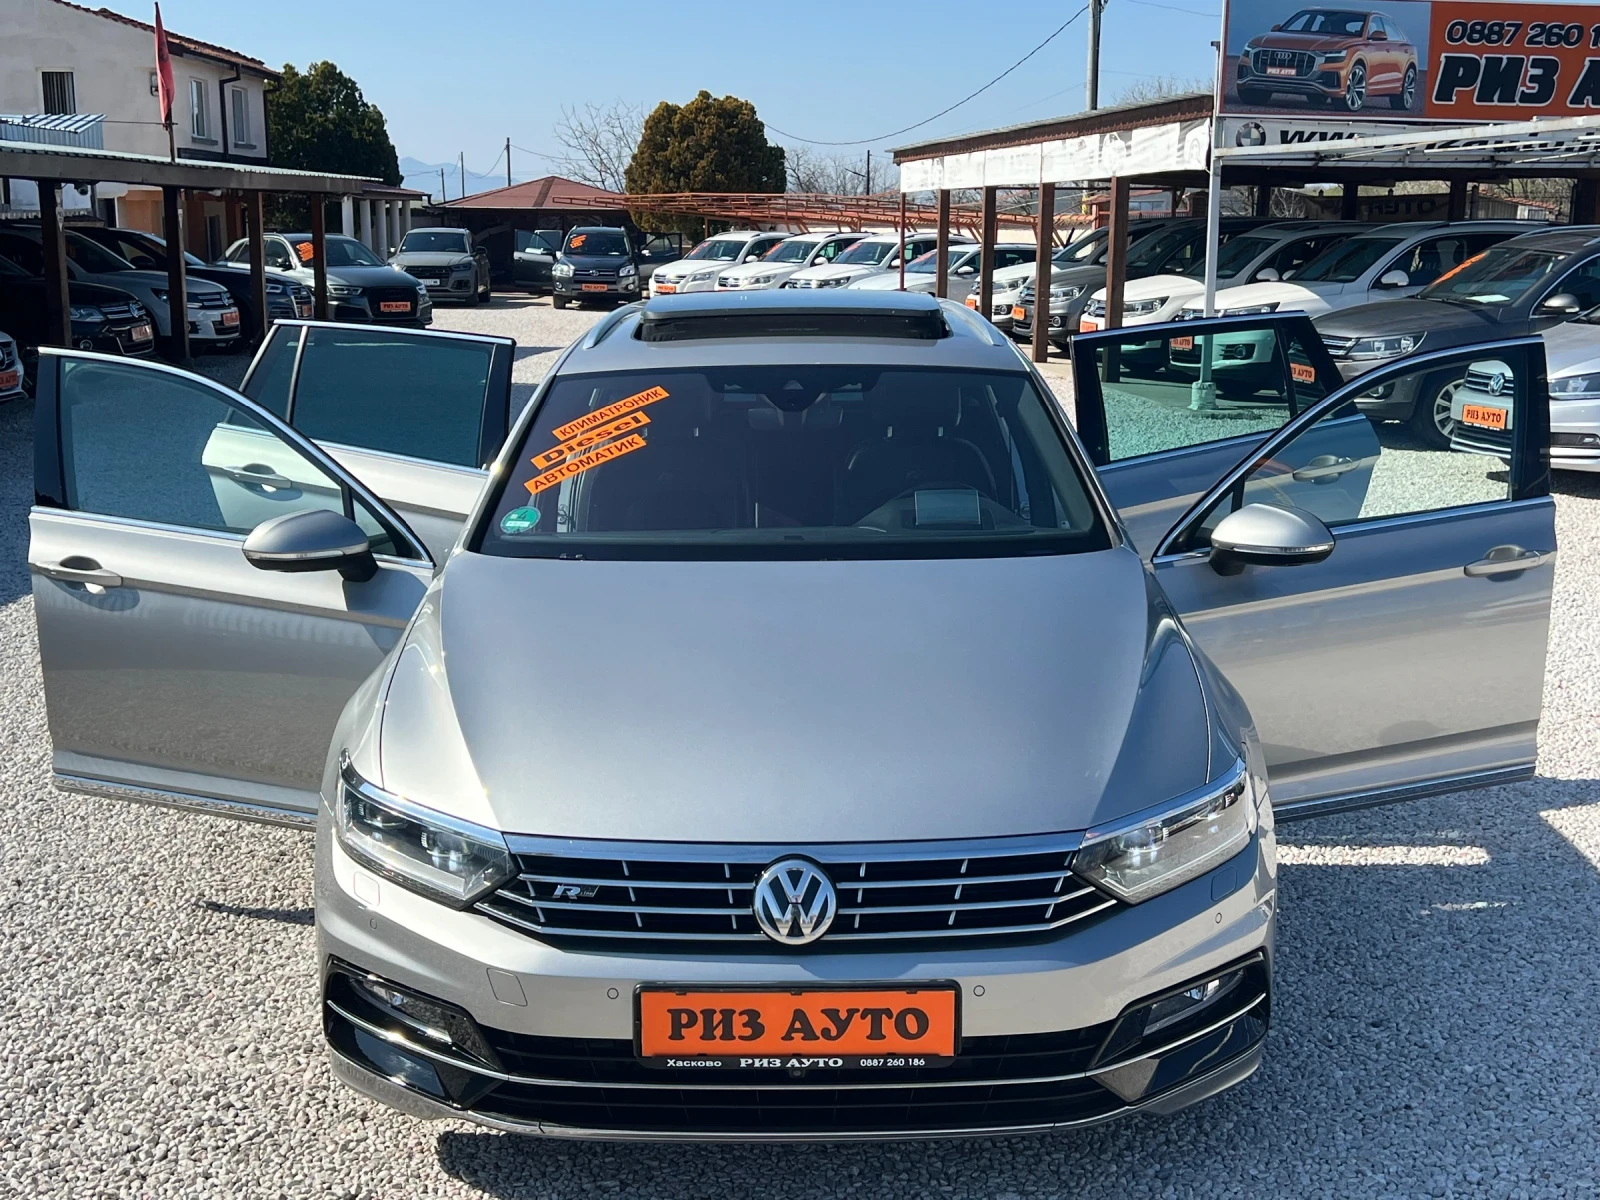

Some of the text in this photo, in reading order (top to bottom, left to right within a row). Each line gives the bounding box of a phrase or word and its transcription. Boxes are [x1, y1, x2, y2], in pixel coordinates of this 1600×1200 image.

[1446, 19, 1523, 46] 0887
[1524, 21, 1584, 48] 260
[1432, 53, 1560, 106] РИЗ
[559, 388, 663, 437] КЛИМАТРОНИК
[1466, 409, 1502, 423] РИЗ АУТО
[543, 415, 643, 463] Diesel
[534, 437, 640, 490] АВТОМАТИК
[667, 1007, 930, 1041] РИЗ АУТО
[666, 1057, 926, 1067] Хасково РИЗ АУТО 0887 260 186
